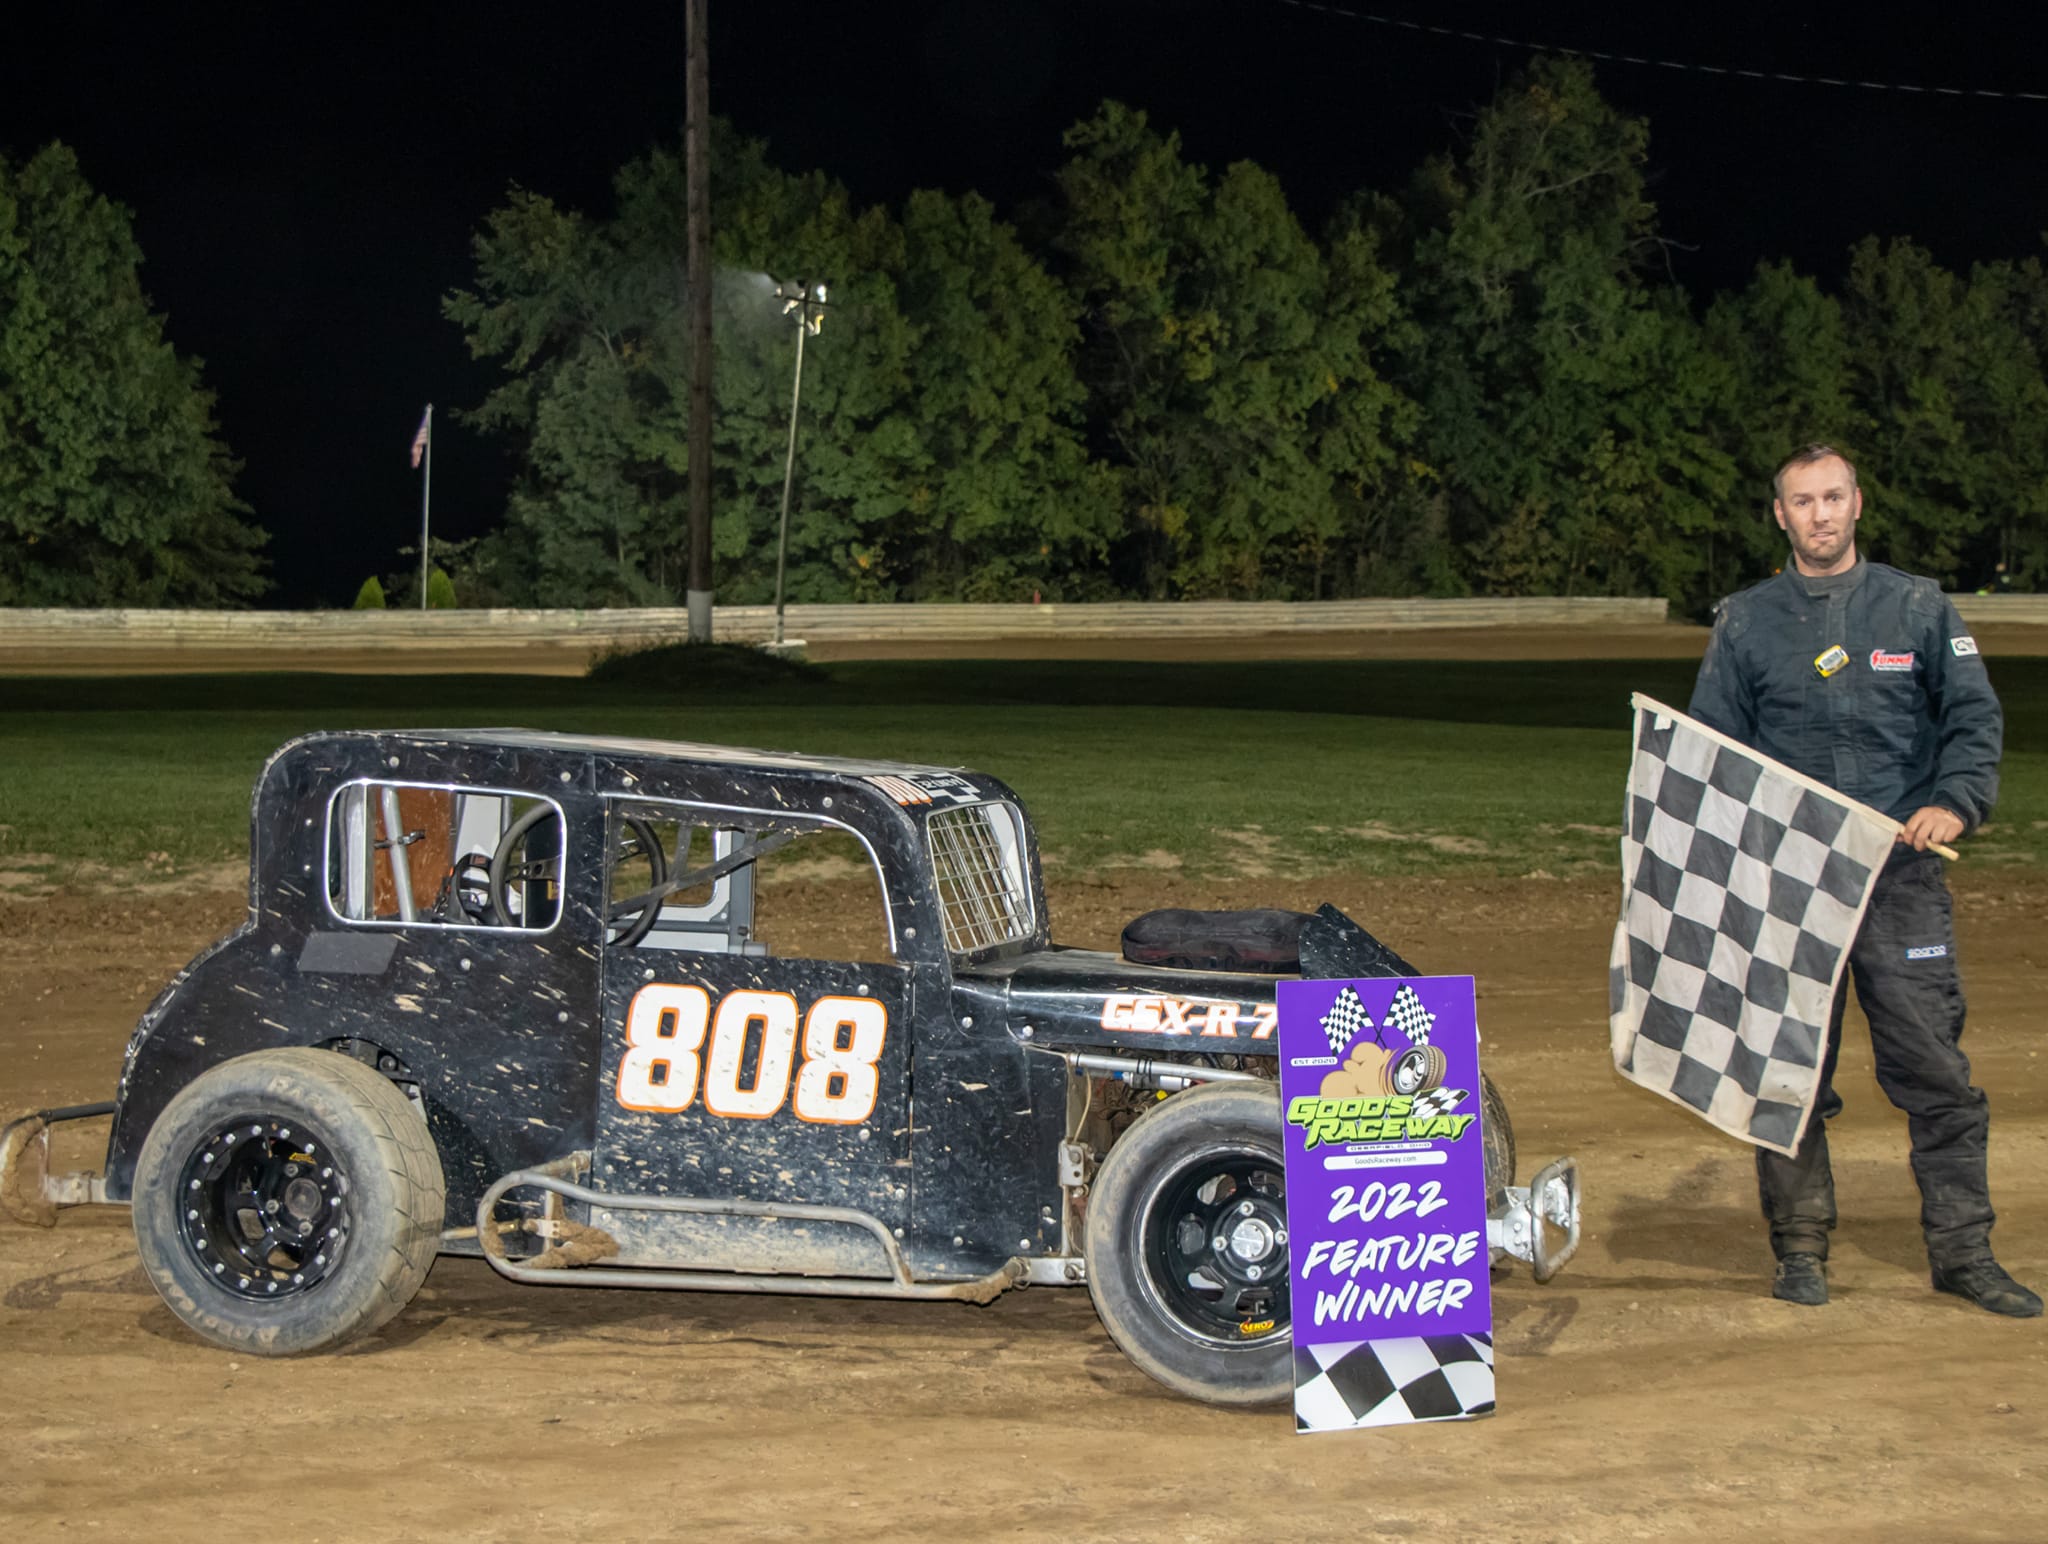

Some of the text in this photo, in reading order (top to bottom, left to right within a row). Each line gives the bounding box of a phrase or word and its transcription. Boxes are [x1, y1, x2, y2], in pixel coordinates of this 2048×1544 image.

[1101, 996, 1241, 1038] GSX-R
[615, 982, 888, 1125] 808
[1287, 1095, 1414, 1125] GOOD'S
[1304, 1114, 1476, 1151] RACEWAY
[1354, 1155, 1417, 1165] GoodsRaceway.com
[1327, 1180, 1449, 1223] 2022
[1301, 1230, 1481, 1280] FEATURE
[1313, 1278, 1473, 1327] WINNER
